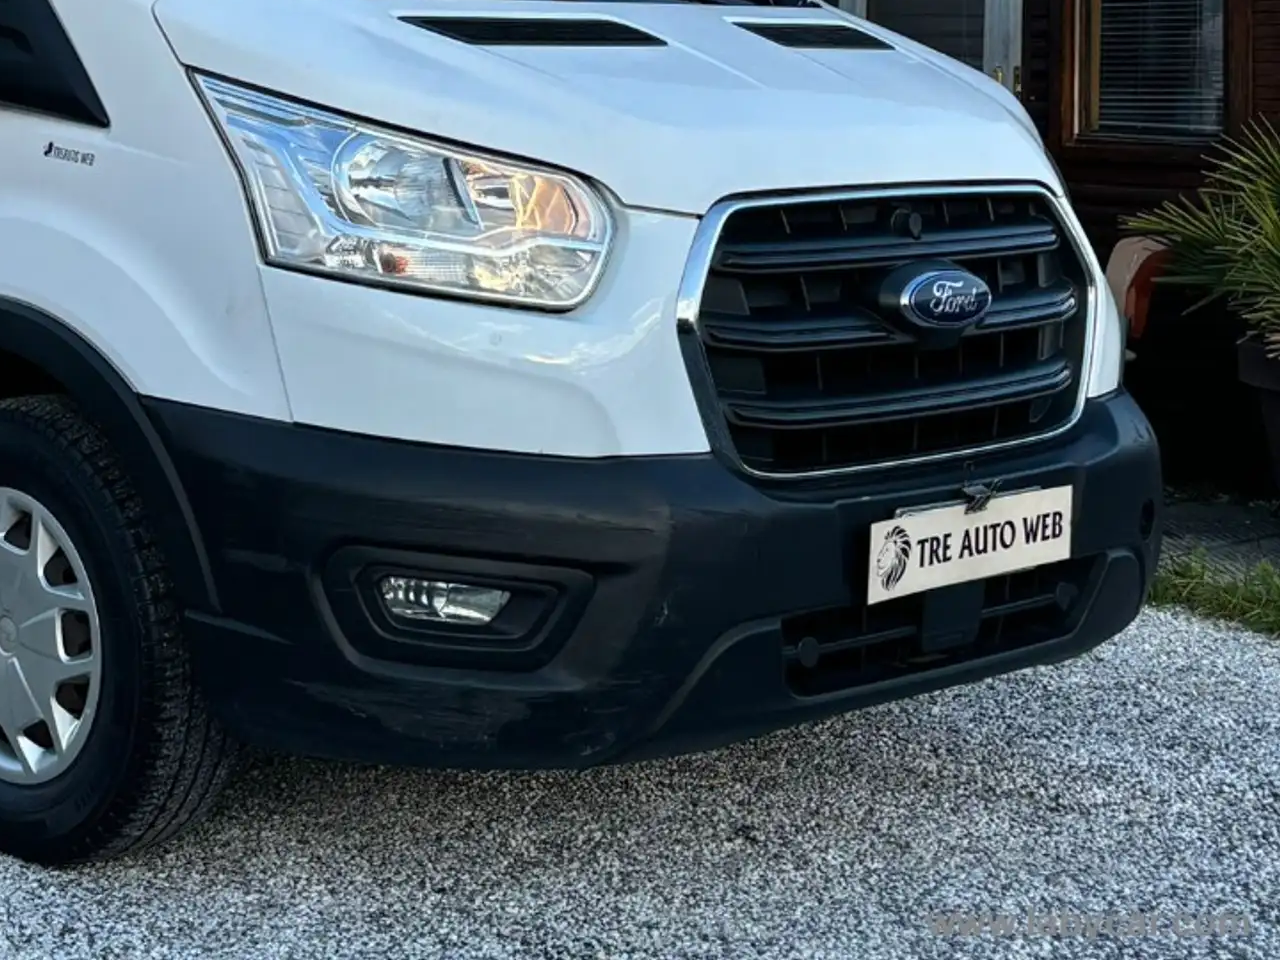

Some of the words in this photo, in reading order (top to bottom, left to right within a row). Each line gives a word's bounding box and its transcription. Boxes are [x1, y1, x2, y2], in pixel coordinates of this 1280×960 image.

[930, 280, 978, 315] Ford
[917, 533, 952, 568] TRE
[958, 520, 1017, 559] AUTO
[1022, 511, 1063, 544] WEB
